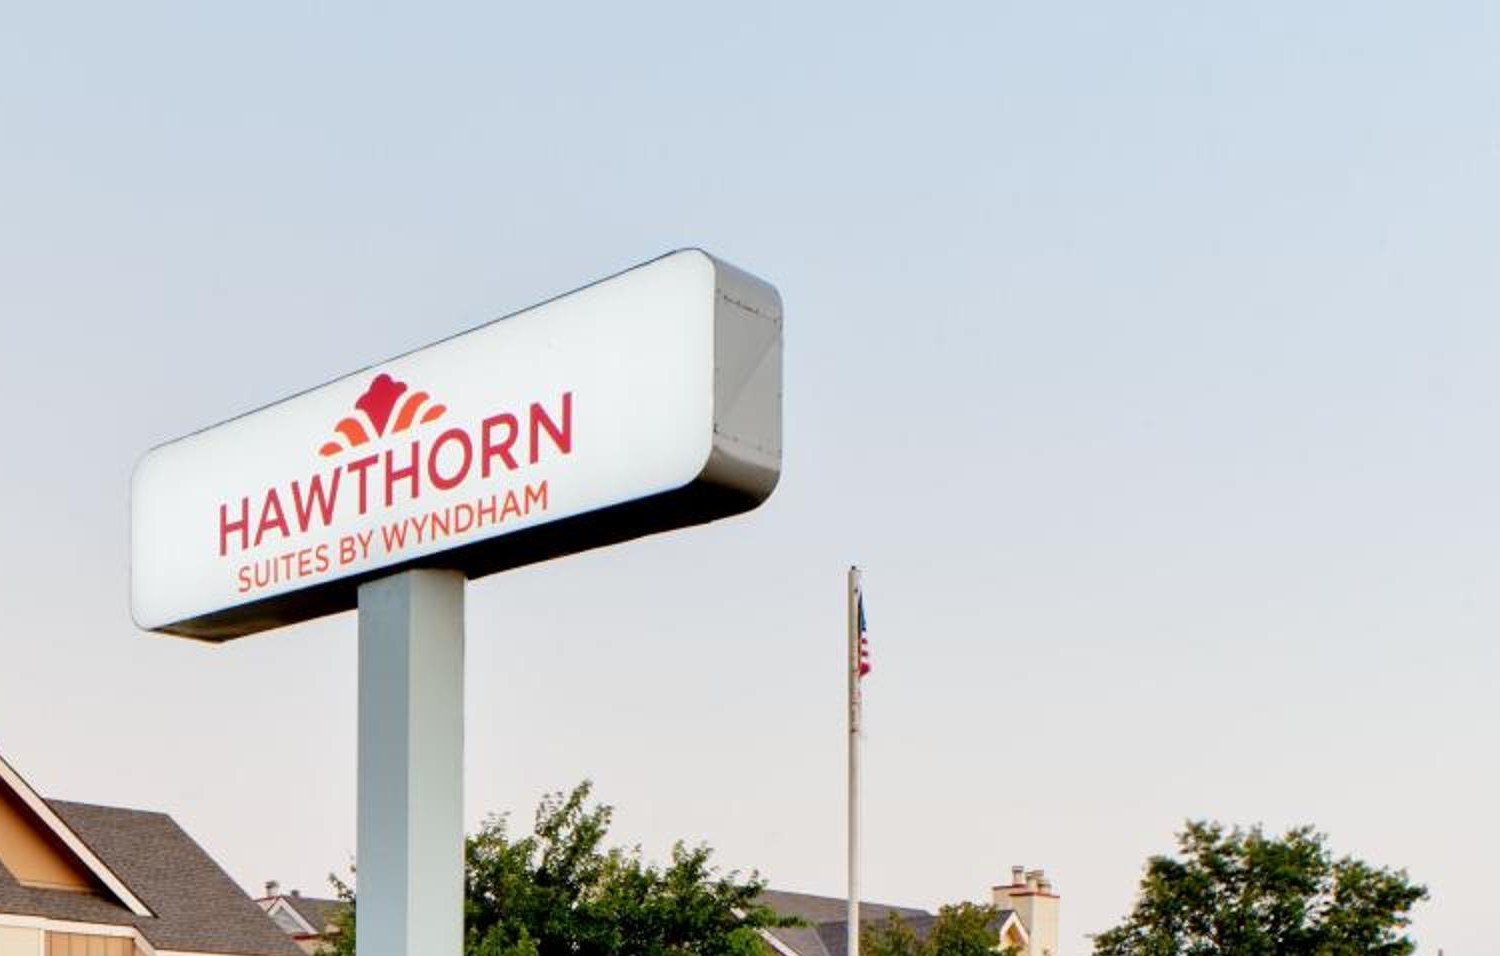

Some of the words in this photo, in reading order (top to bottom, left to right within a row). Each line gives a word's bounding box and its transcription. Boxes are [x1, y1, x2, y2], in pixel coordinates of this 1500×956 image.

[218, 392, 573, 556] HAWTHORN
[237, 545, 331, 594] SUITES
[339, 529, 376, 568] BY
[380, 480, 550, 554] WYNDHAM
